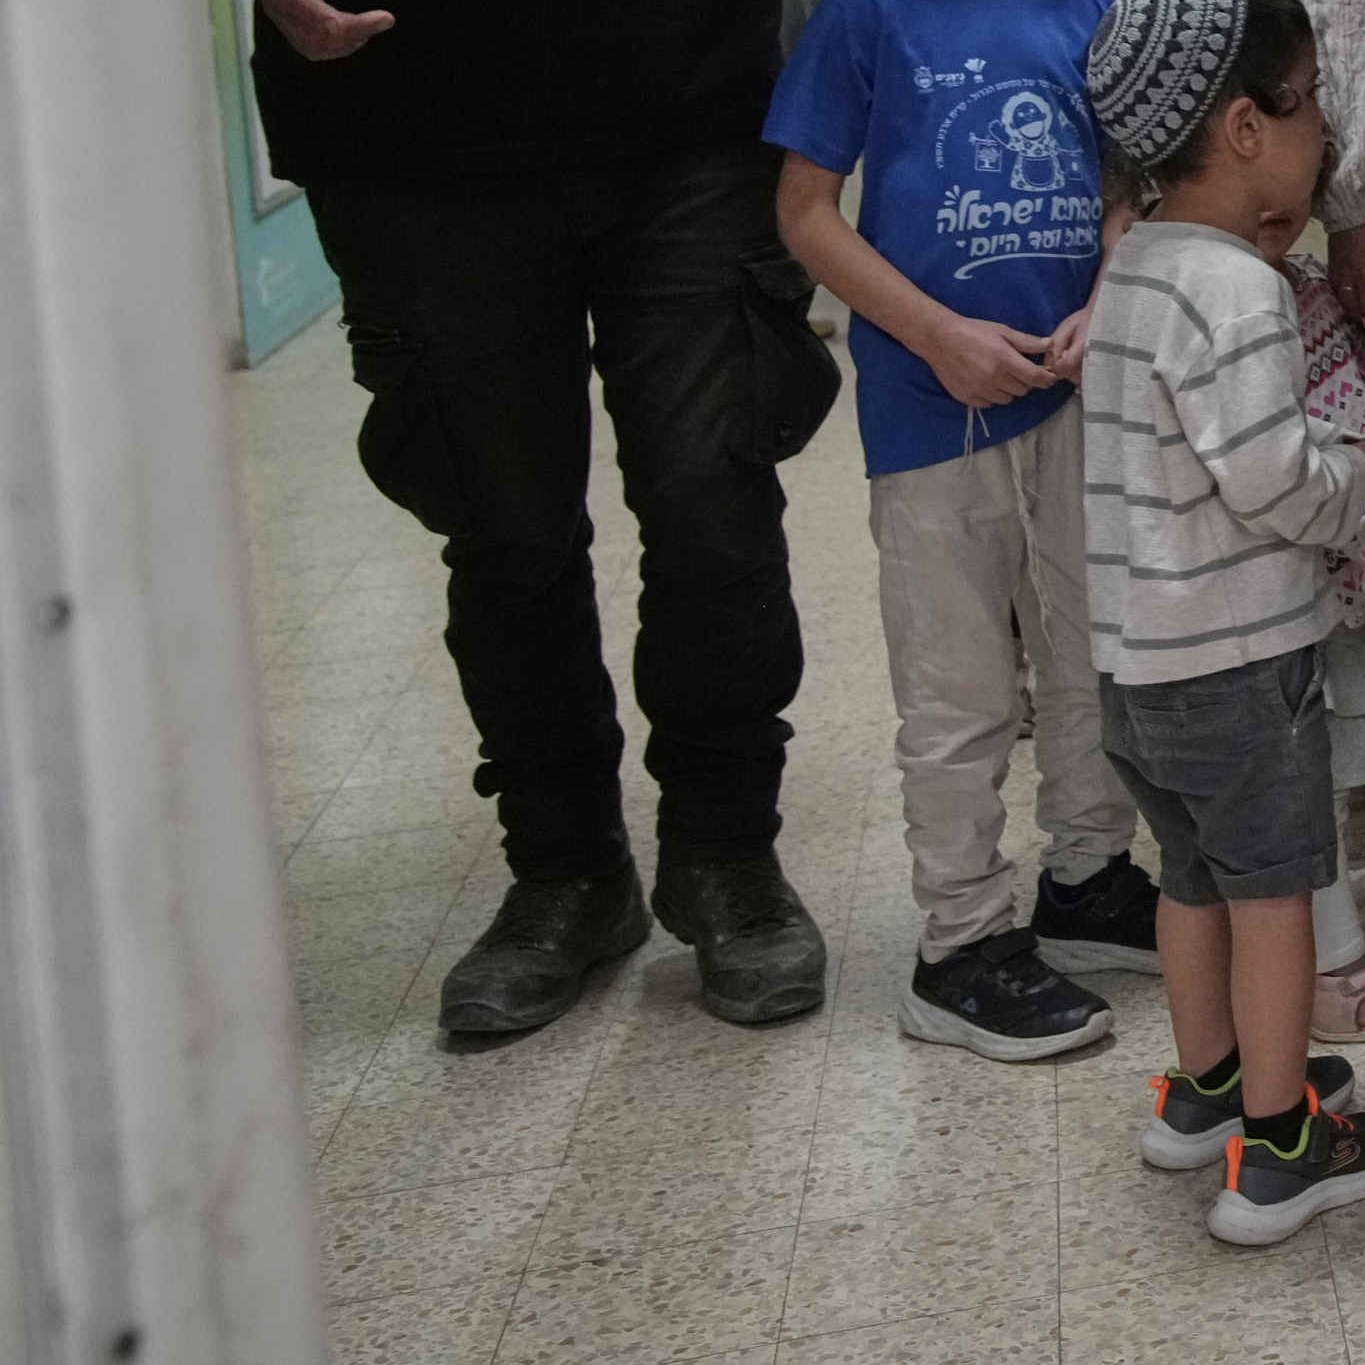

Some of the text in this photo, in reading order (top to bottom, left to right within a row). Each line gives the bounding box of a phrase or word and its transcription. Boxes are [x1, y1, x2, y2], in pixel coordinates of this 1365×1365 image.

[936, 190, 1103, 234] סבתא ישראלה
[970, 233, 1021, 257] היום
[1028, 228, 1061, 250] ועד
